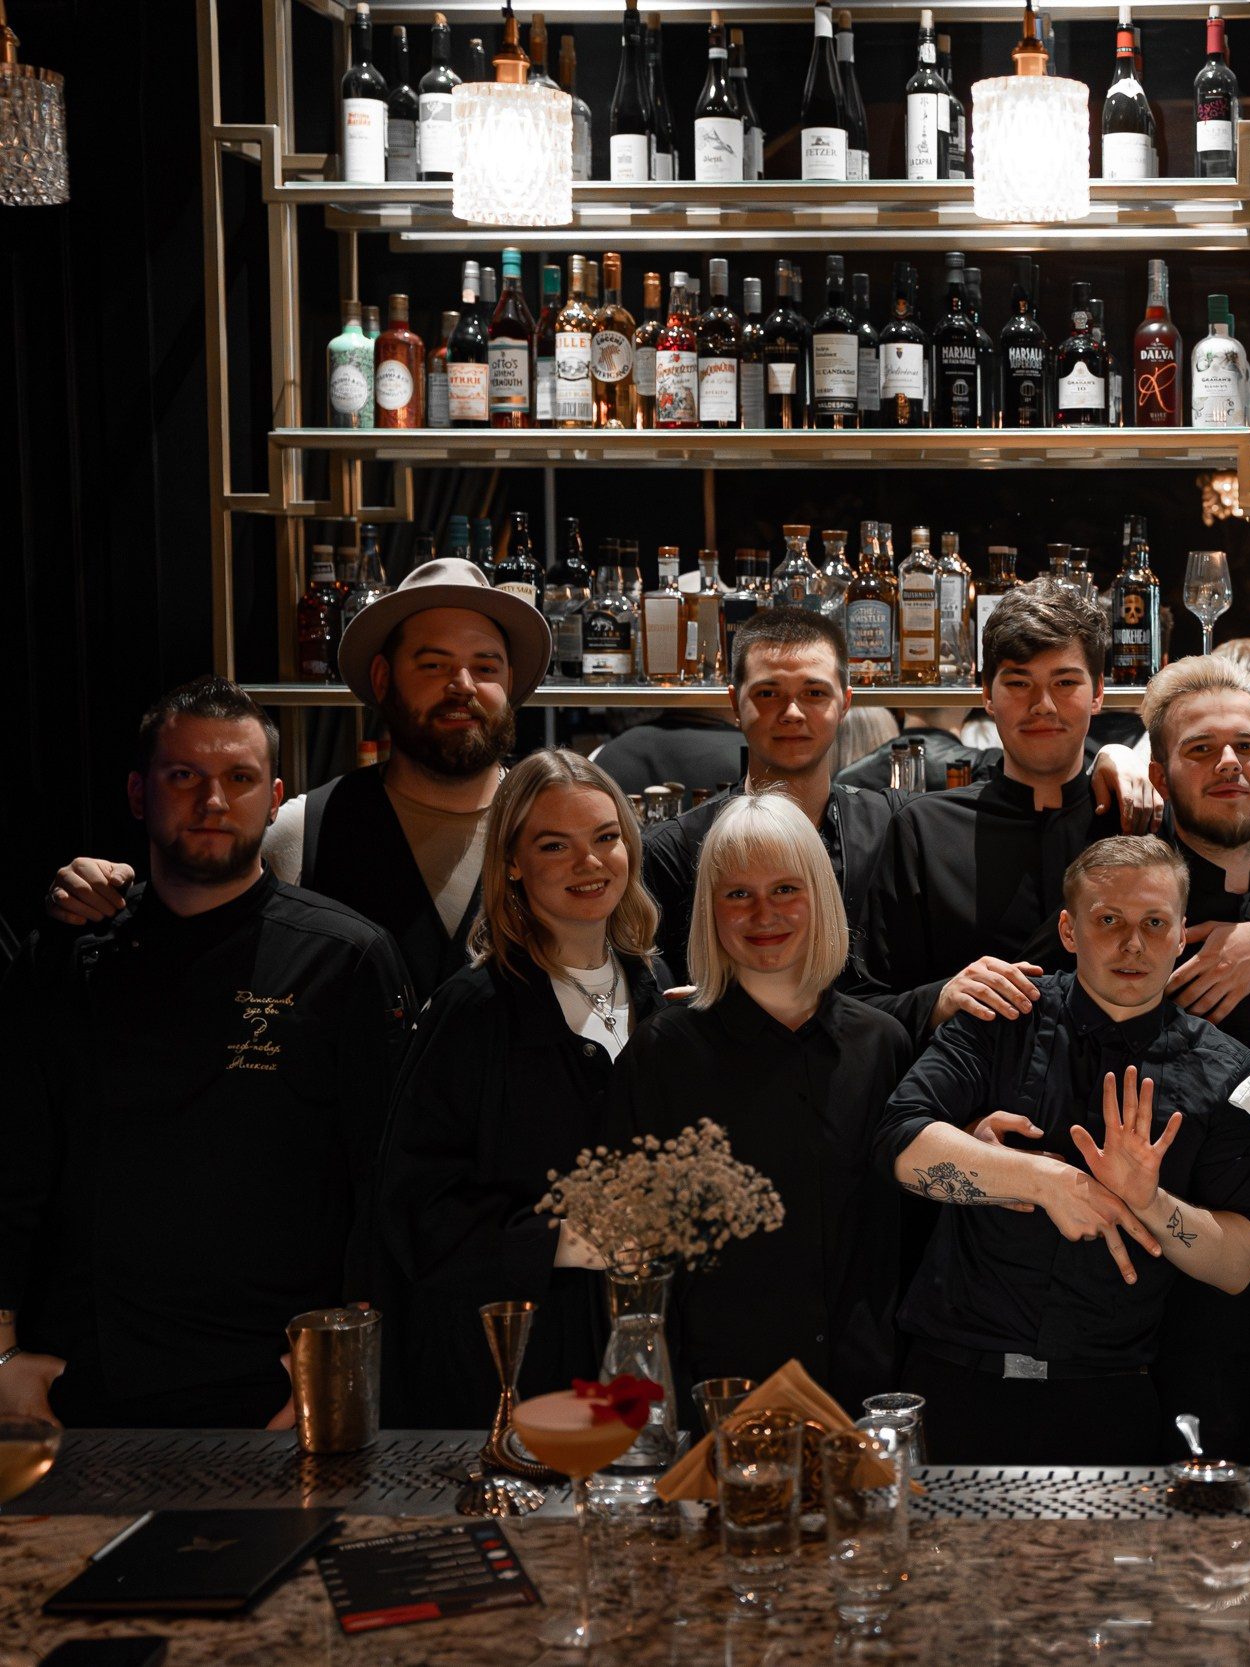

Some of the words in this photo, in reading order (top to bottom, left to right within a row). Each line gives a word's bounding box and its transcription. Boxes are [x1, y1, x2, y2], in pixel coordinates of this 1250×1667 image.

[915, 158, 933, 166] CAPRA
[942, 346, 976, 359] MARSALA
[1009, 347, 1043, 360] MARSALA
[1140, 350, 1174, 360] DALVA
[903, 591, 935, 599] BUSHMILLS
